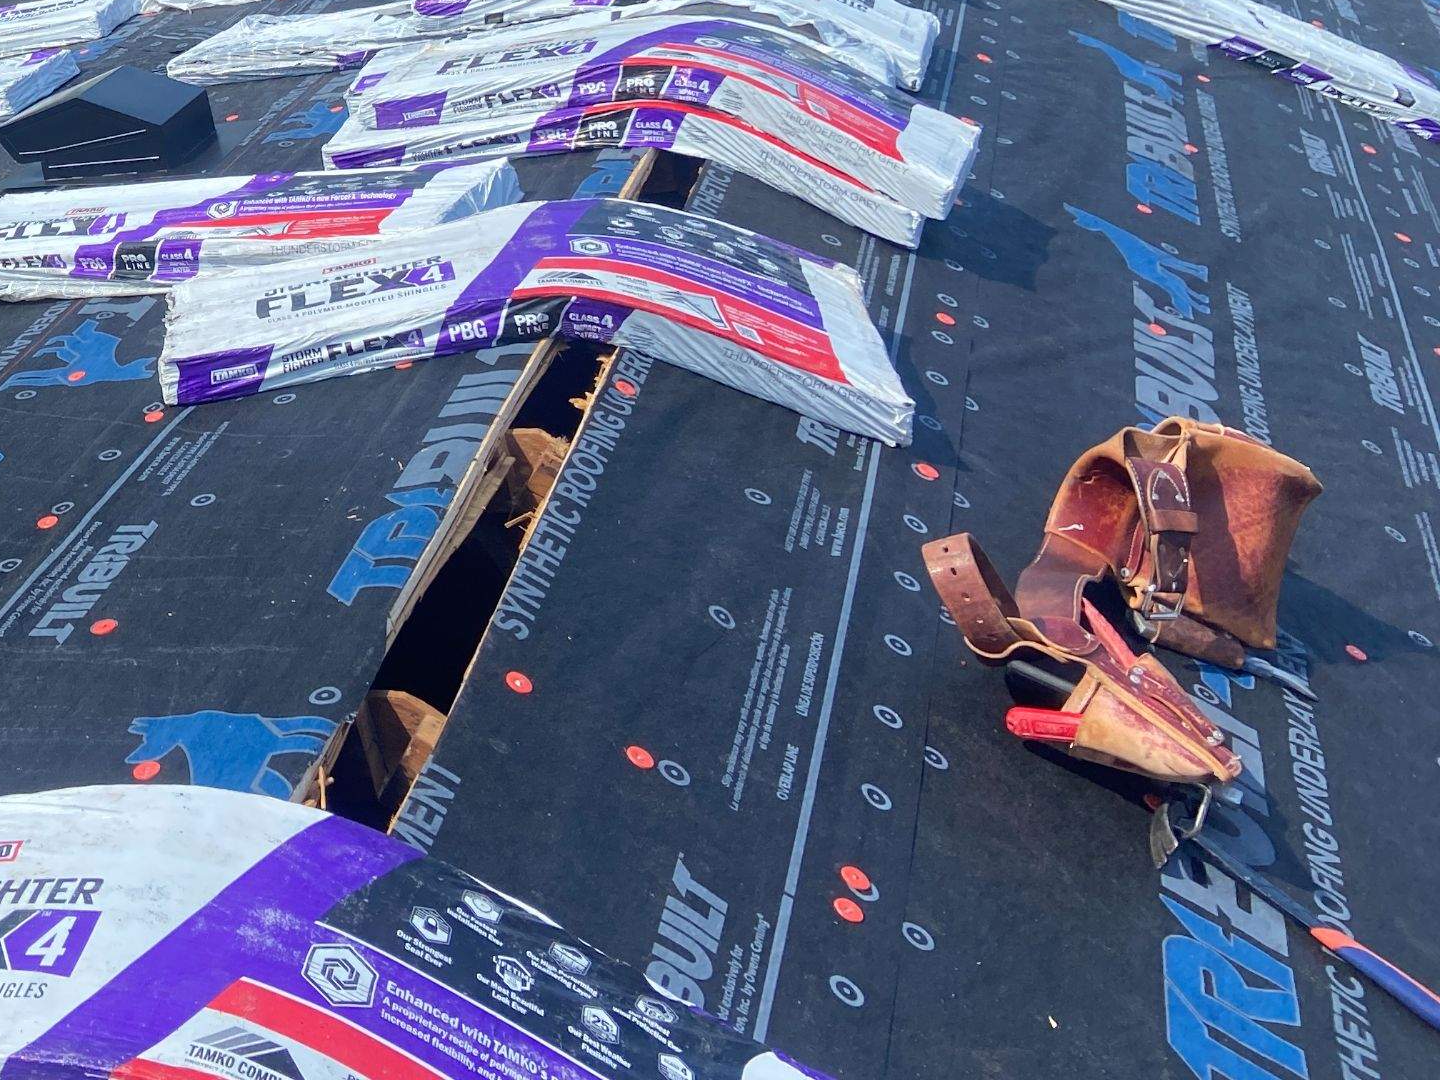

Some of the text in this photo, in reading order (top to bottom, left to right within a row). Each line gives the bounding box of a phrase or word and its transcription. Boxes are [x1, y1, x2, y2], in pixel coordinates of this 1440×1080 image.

[626, 78, 655, 87] PRO
[698, 80, 710, 94] 4
[588, 120, 618, 131] PRO
[589, 130, 620, 139] LINE
[635, 118, 674, 132] CLASS 4
[120, 253, 147, 262] PRO
[125, 261, 151, 270] LINE
[184, 248, 194, 260] 4
[256, 264, 444, 320] FLEX4
[448, 319, 489, 342] PBG
[513, 313, 550, 327] PRO
[517, 324, 551, 336] LINE
[568, 312, 614, 329] CLASS 4
[281, 346, 322, 363] STORM
[327, 329, 423, 361] FLEX4
[213, 365, 257, 382] TAMKO
[491, 418, 619, 642] SYNTHETIC ROOFING
[28, 519, 160, 646] TRIBUILT
[785, 743, 799, 765] LINE
[776, 763, 796, 801] OVERLAP
[487, 932, 504, 947] Ever
[643, 856, 730, 1009] BUILT
[396, 929, 453, 965] Our Strongest
[404, 942, 443, 968] Seal Ever
[722, 943, 744, 1008] exclusively for
[743, 951, 760, 984] Owens
[476, 973, 545, 1017] Our Most Beautiful
[740, 980, 757, 997] by
[386, 980, 460, 1030] Enhanced
[461, 1023, 492, 1048] with
[491, 990, 528, 1015] Look Ever
[382, 996, 490, 1062] A proprietary recipe of
[188, 1043, 236, 1069] TAMKO
[381, 1008, 497, 1080] Increased flexibility, and
[567, 1025, 632, 1069] Our Best Weather
[581, 1043, 618, 1070] Flexibility
